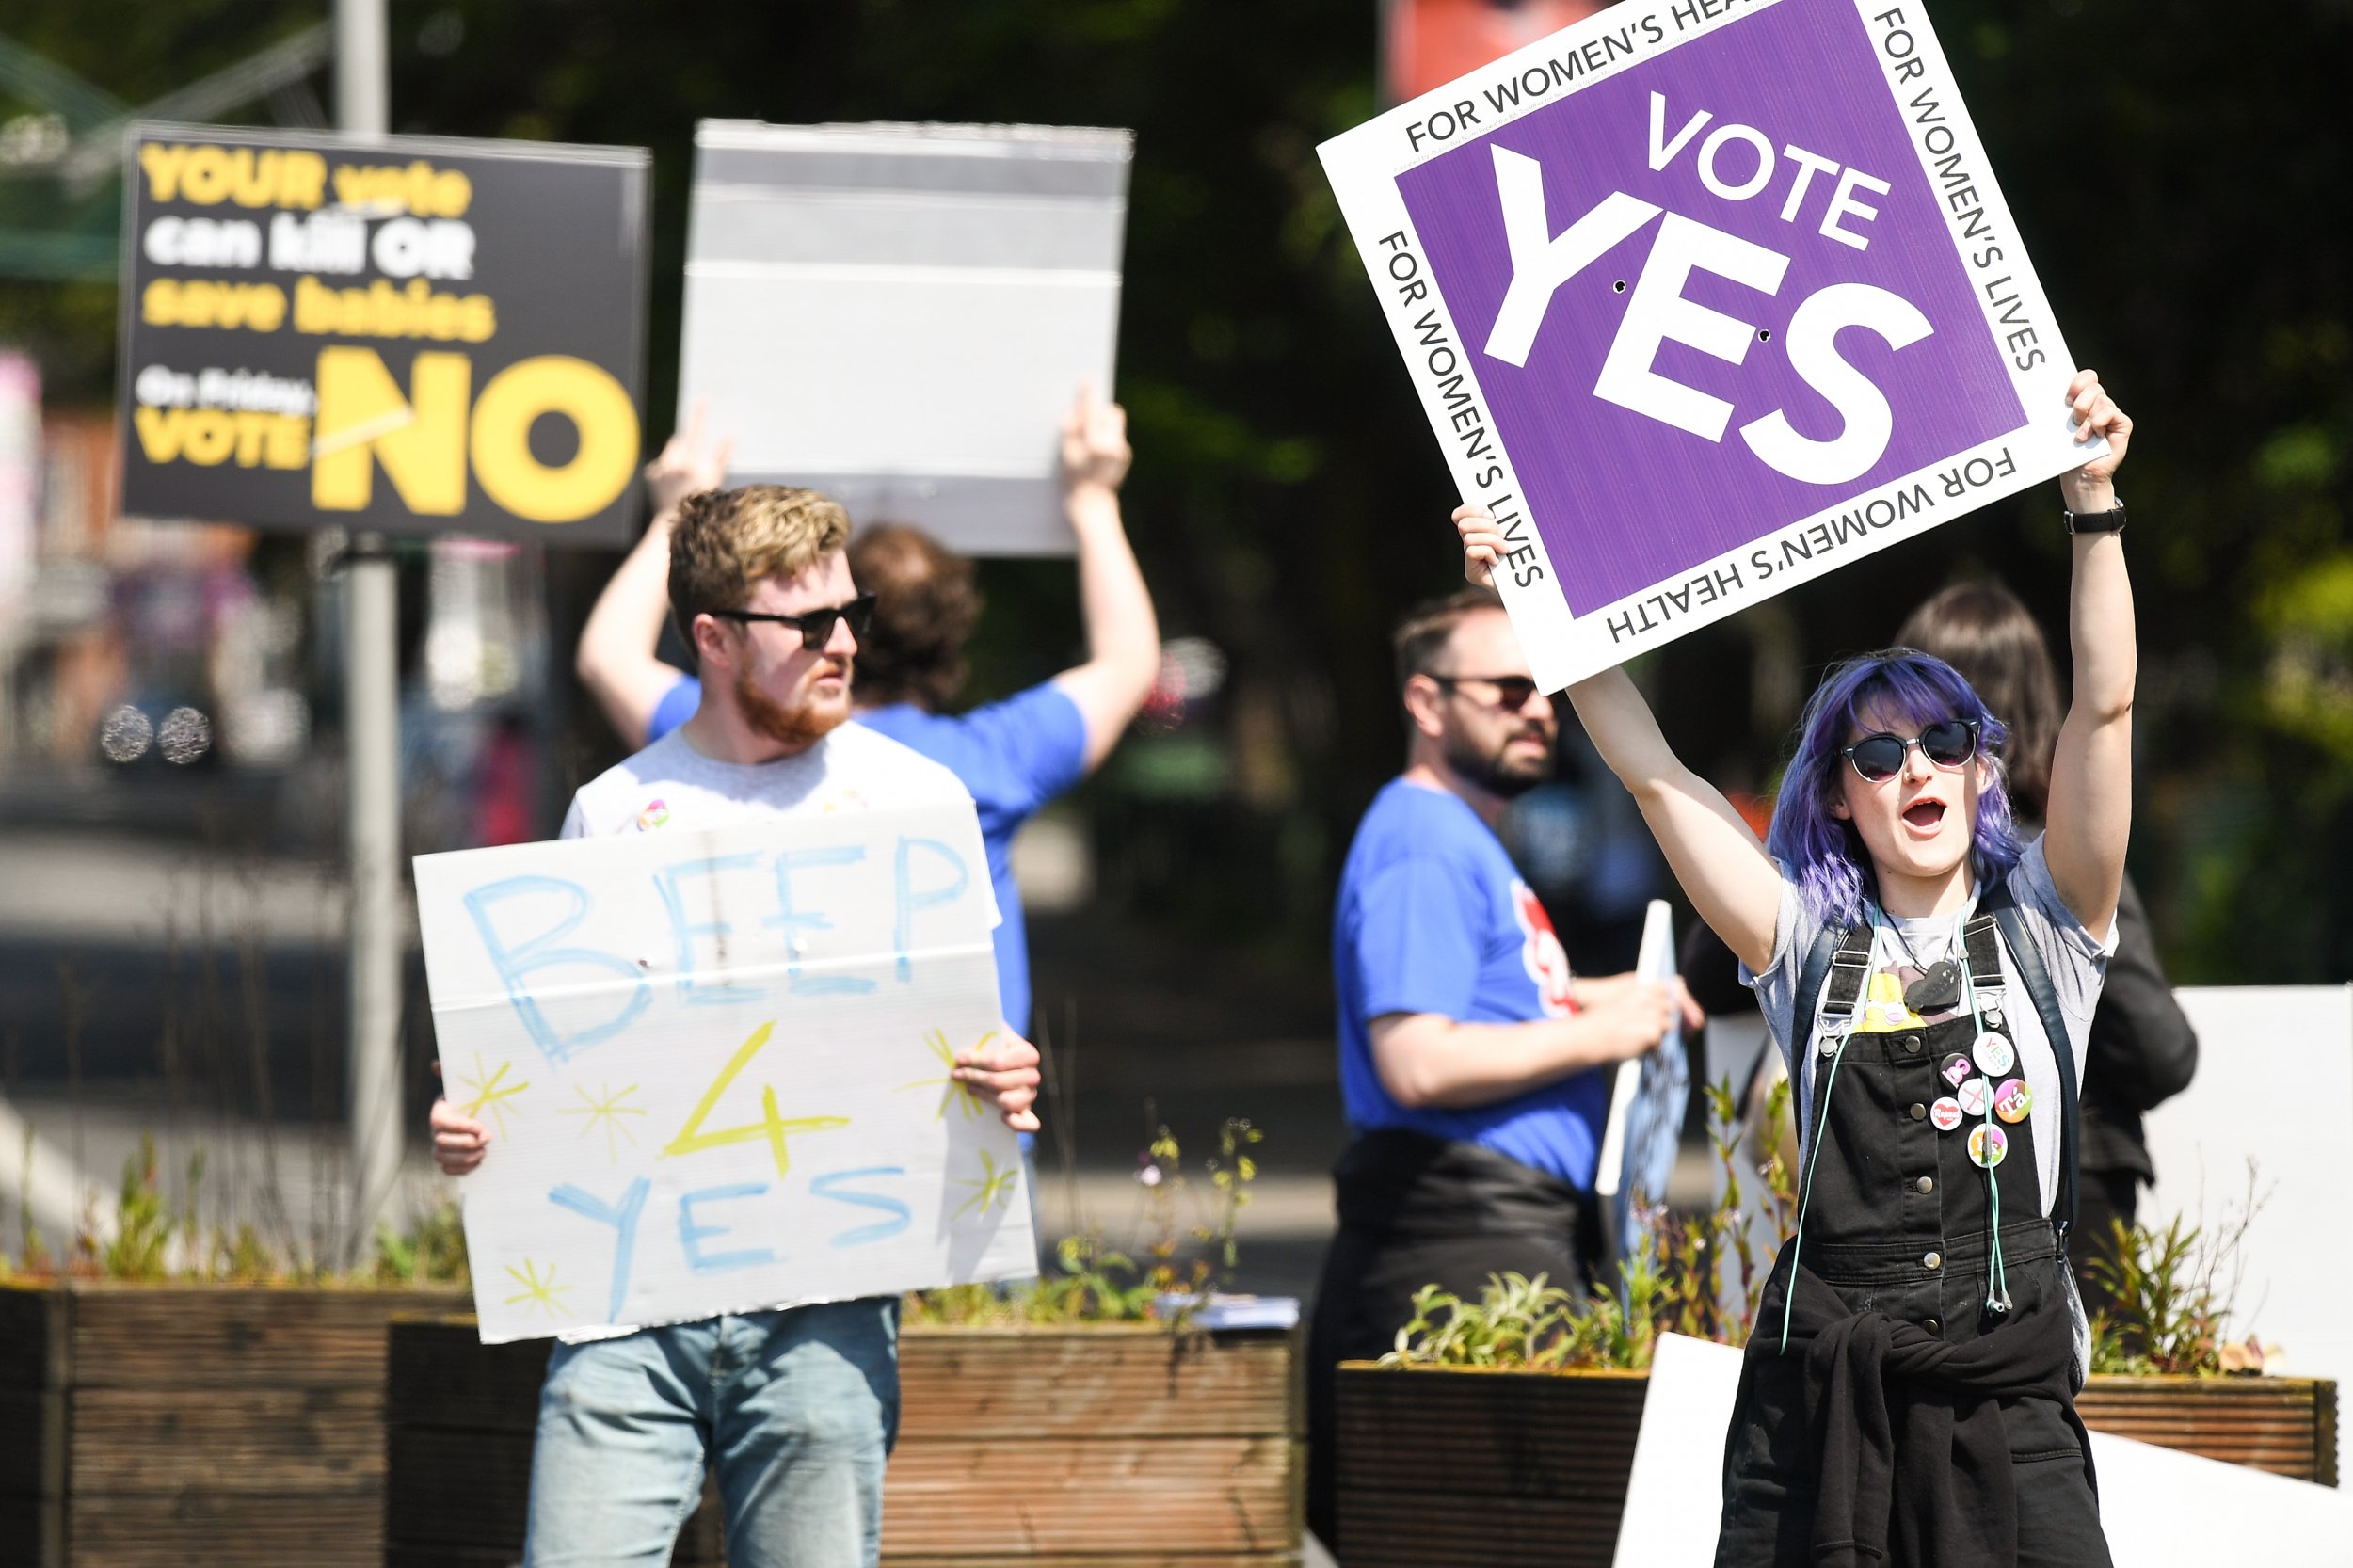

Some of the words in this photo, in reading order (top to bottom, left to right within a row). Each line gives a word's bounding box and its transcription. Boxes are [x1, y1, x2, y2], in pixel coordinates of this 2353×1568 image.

[1406, 101, 1481, 152] FOR
[1483, 15, 1663, 113] WOMEN'S
[140, 143, 328, 211] YOUR
[332, 160, 472, 218] vote
[1649, 91, 1891, 250] VOTE
[1875, 8, 1924, 84] FOR
[1910, 87, 2003, 268] WOMEN'S
[1986, 276, 2045, 370] LIVES
[142, 279, 288, 332] save
[294, 275, 497, 343] babies
[144, 216, 262, 268] can
[270, 211, 368, 275] kill
[372, 219, 476, 280] OR
[1484, 144, 1934, 484] YES
[135, 405, 313, 470] VOTE
[312, 345, 640, 523] NO
[136, 366, 196, 408] On
[1379, 232, 1427, 307] FOR
[1414, 309, 1503, 488] WOMEN'S
[1487, 493, 1544, 588] LIVES
[1752, 485, 1934, 579] WOMEN'S
[1940, 448, 2016, 497] FOR
[1607, 564, 1743, 643] HEALTH
[463, 834, 968, 1071] BEEP
[661, 1019, 851, 1179] 4
[1986, 1037, 2009, 1067] YES
[548, 1166, 911, 1325] YES
